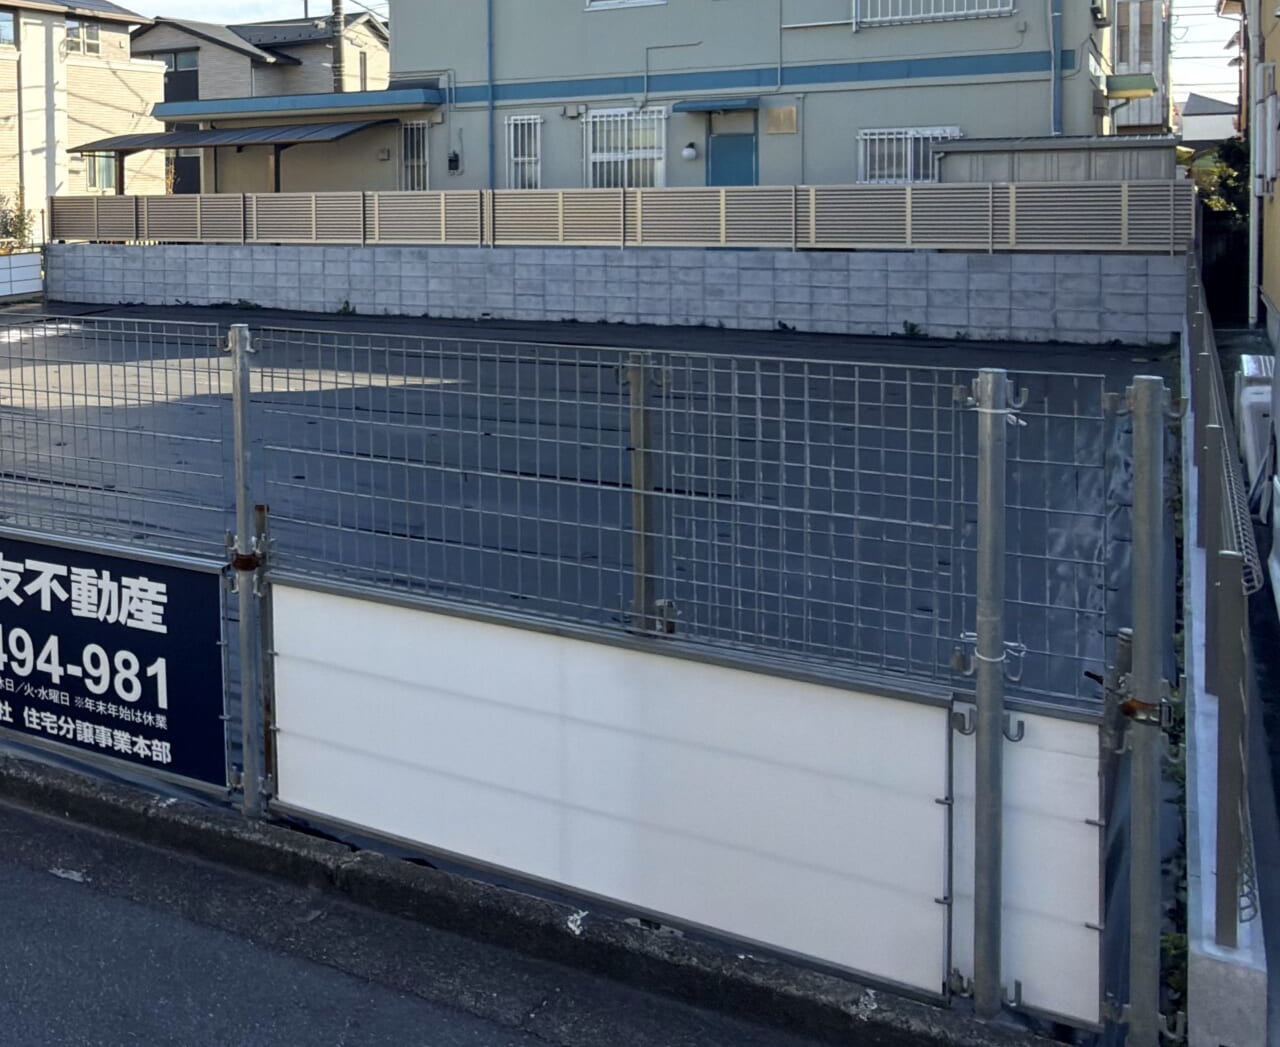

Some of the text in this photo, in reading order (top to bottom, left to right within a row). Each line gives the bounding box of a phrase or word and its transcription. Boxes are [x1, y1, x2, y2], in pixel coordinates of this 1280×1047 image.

[23, 706, 172, 764] 住宅分譲事業本部
